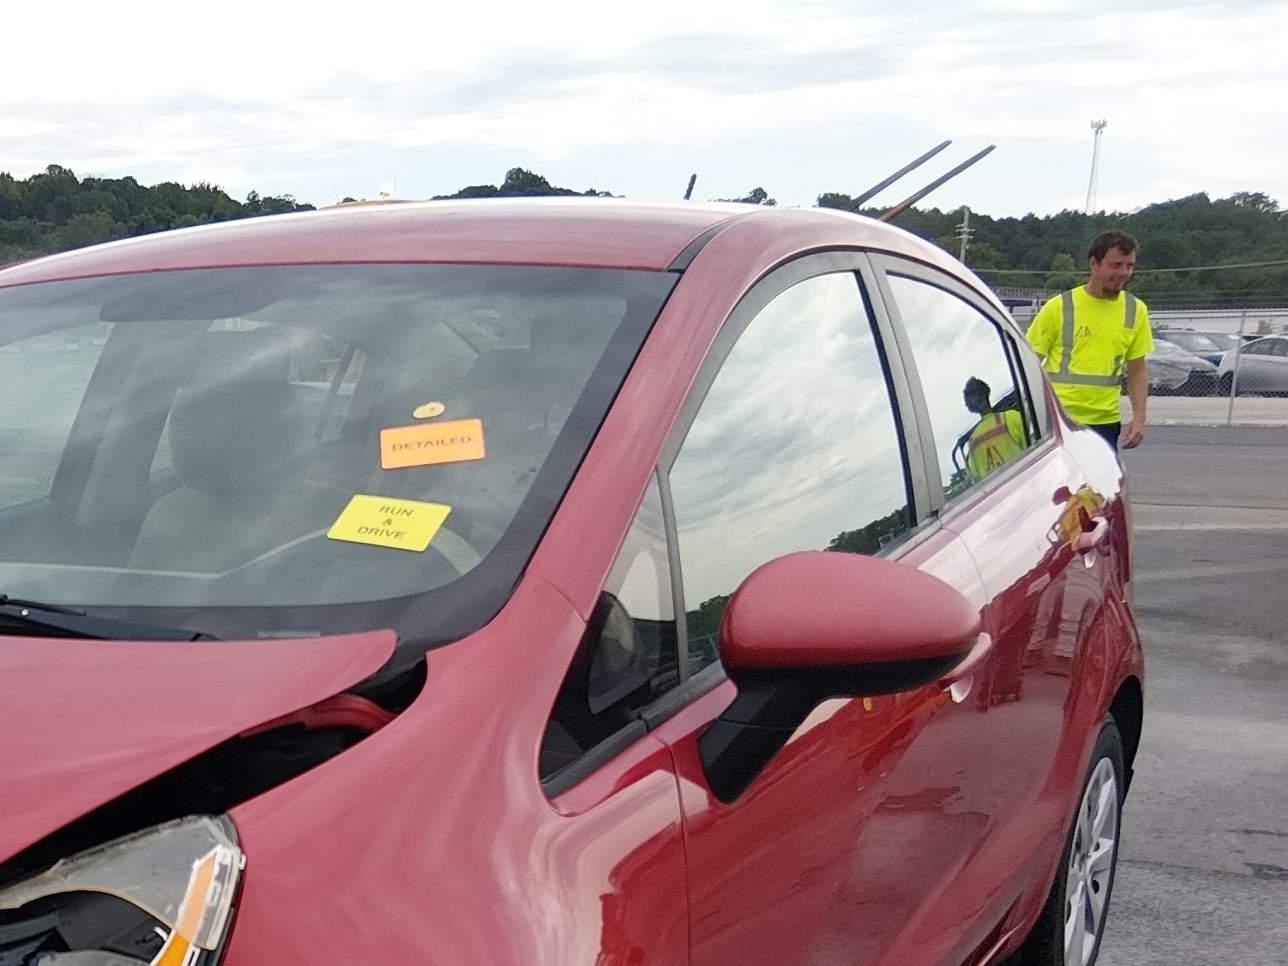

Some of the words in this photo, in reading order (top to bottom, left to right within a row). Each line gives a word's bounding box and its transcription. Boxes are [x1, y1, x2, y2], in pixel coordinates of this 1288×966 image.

[392, 436, 472, 452] DETAILED
[378, 505, 414, 517] RUN
[357, 526, 407, 539] DRIVE
